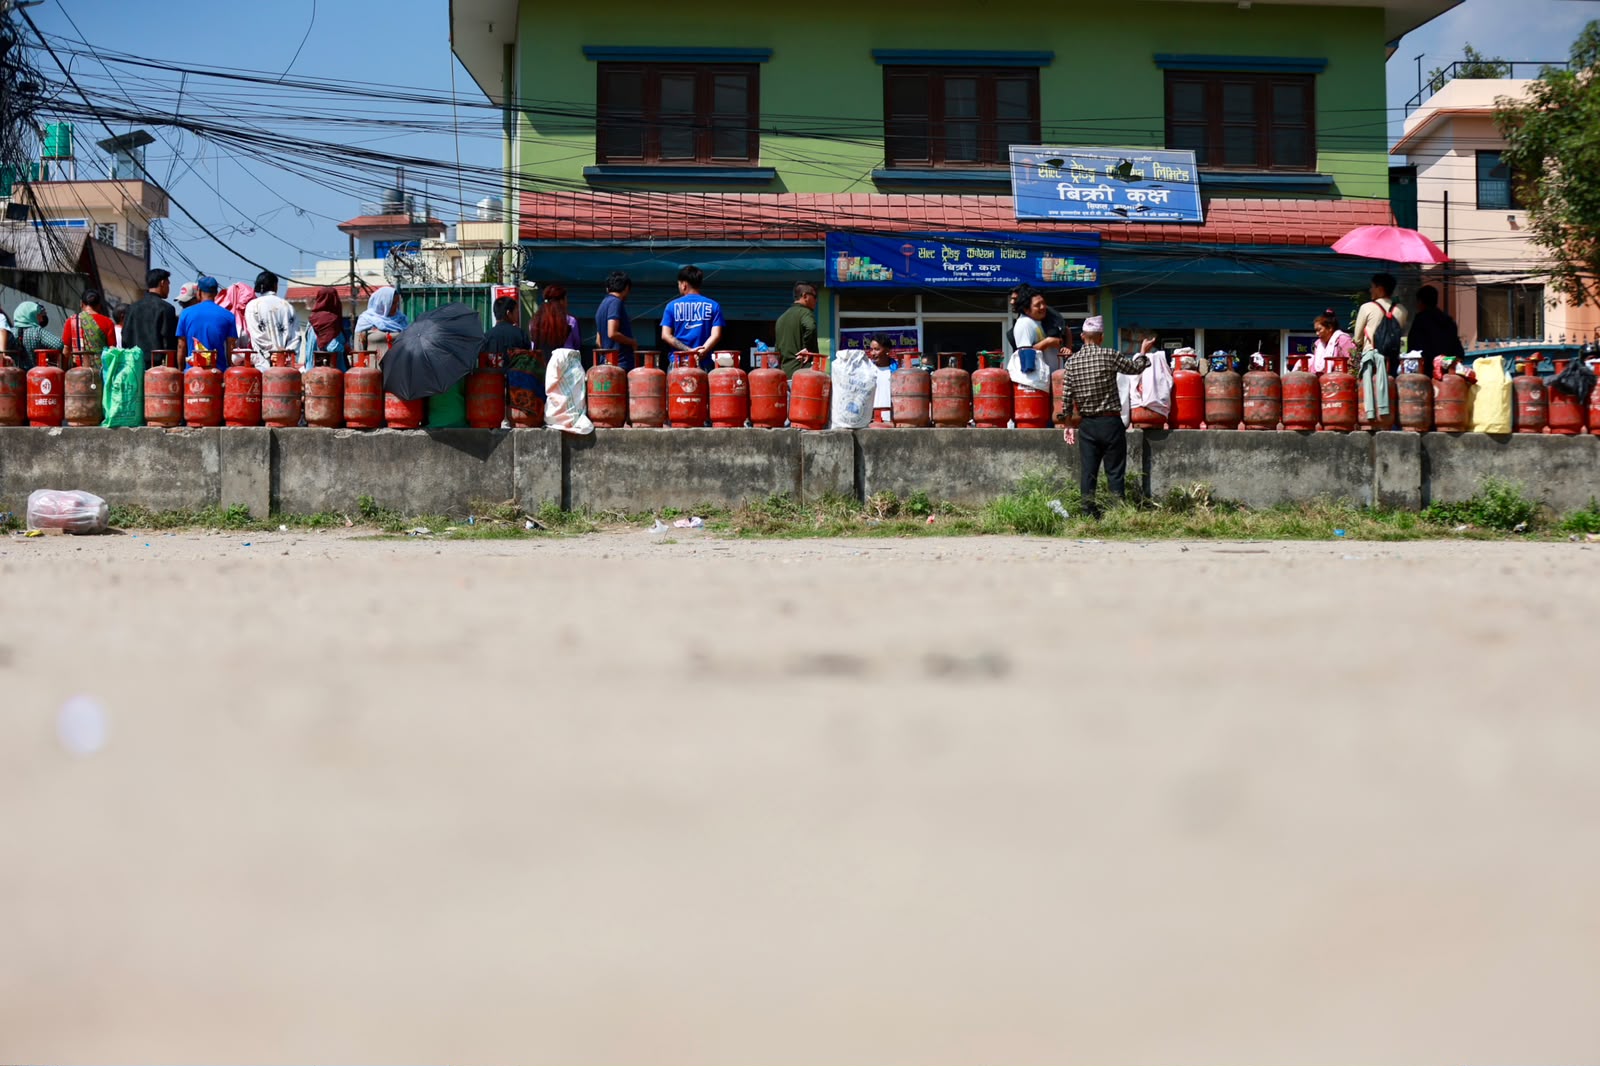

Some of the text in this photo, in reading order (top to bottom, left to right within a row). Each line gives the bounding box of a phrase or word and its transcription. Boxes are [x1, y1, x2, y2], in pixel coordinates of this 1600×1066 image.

[1056, 182, 1171, 204] बिक्री कक्ष
[943, 262, 1002, 272] बिक्री कक्ष
[674, 302, 712, 323] NIKE
